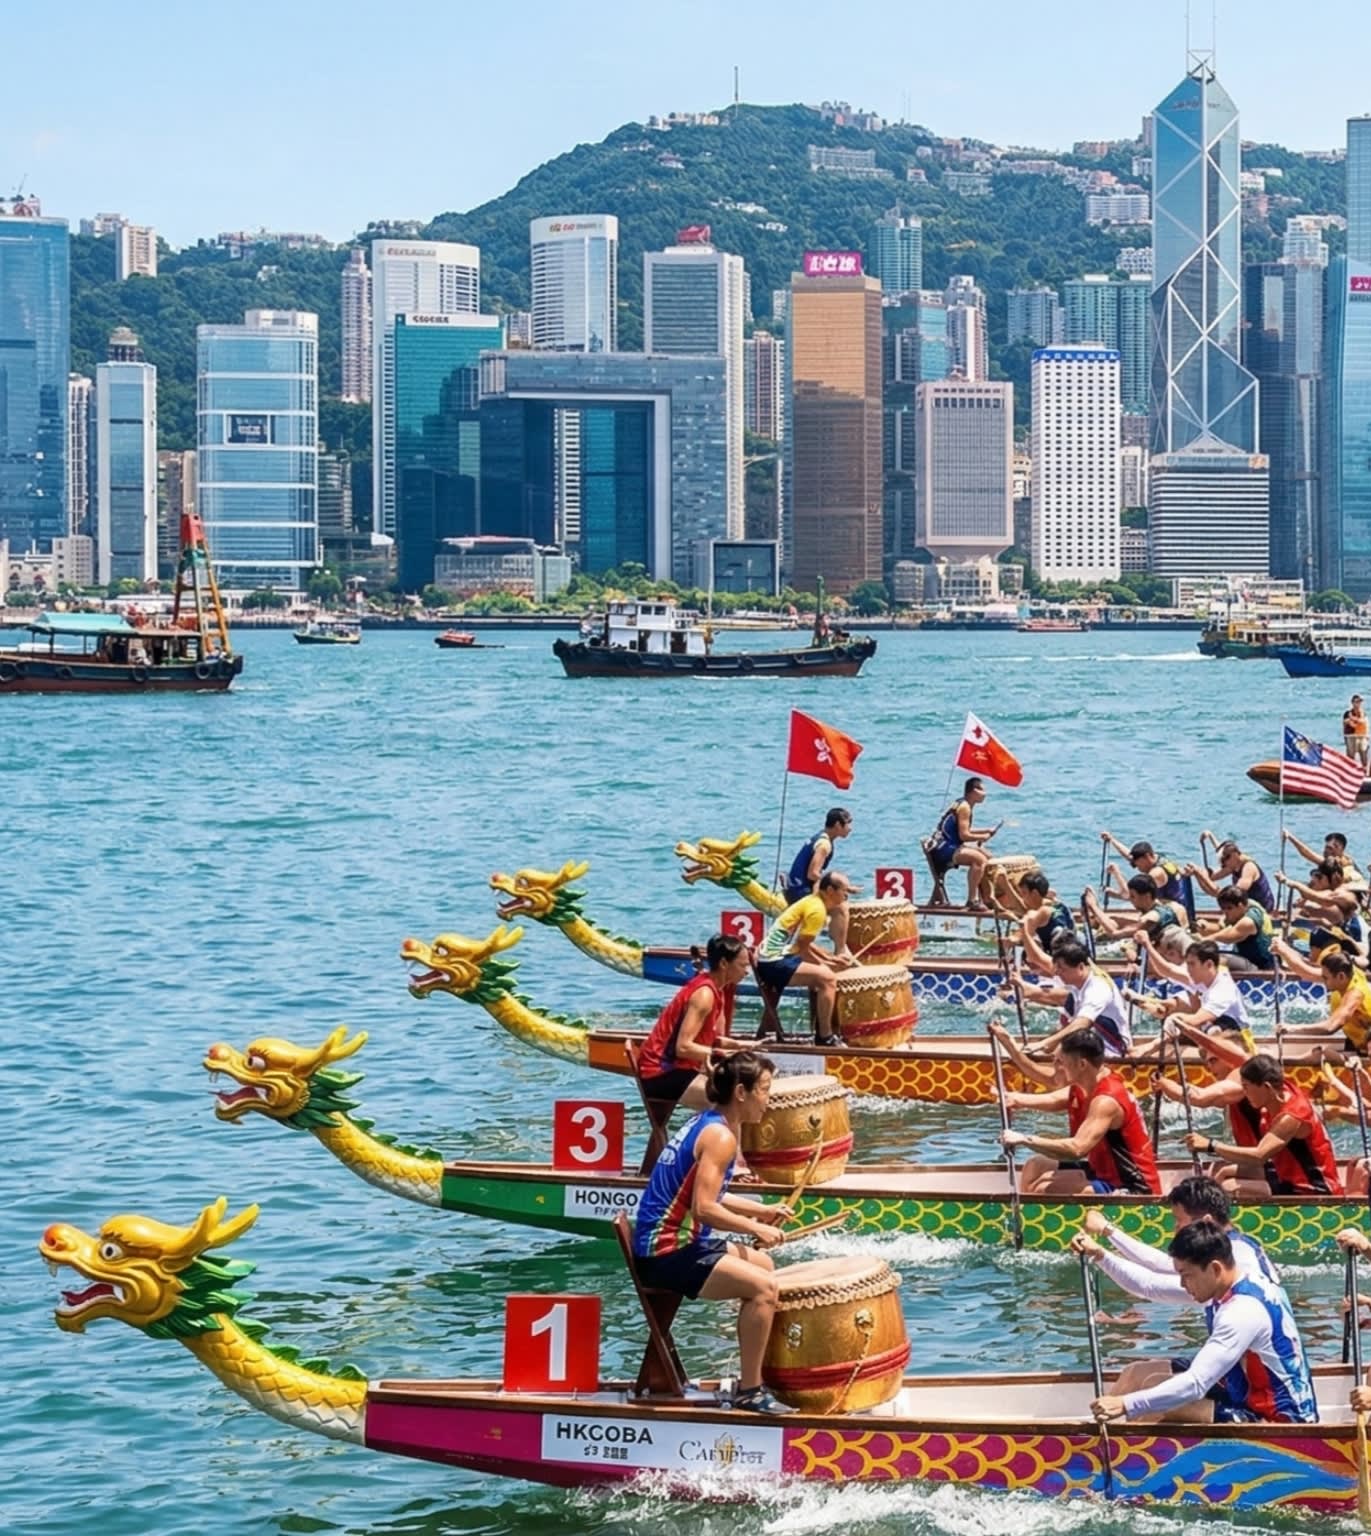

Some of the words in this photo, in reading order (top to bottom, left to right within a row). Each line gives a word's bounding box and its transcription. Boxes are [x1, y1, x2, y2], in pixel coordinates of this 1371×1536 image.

[884, 870, 906, 900] 3
[731, 914, 755, 948] 3
[568, 1106, 609, 1164] 3
[575, 1189, 638, 1207] HONGO
[531, 1303, 568, 1382] 1
[556, 1421, 654, 1446] HKCOBA
